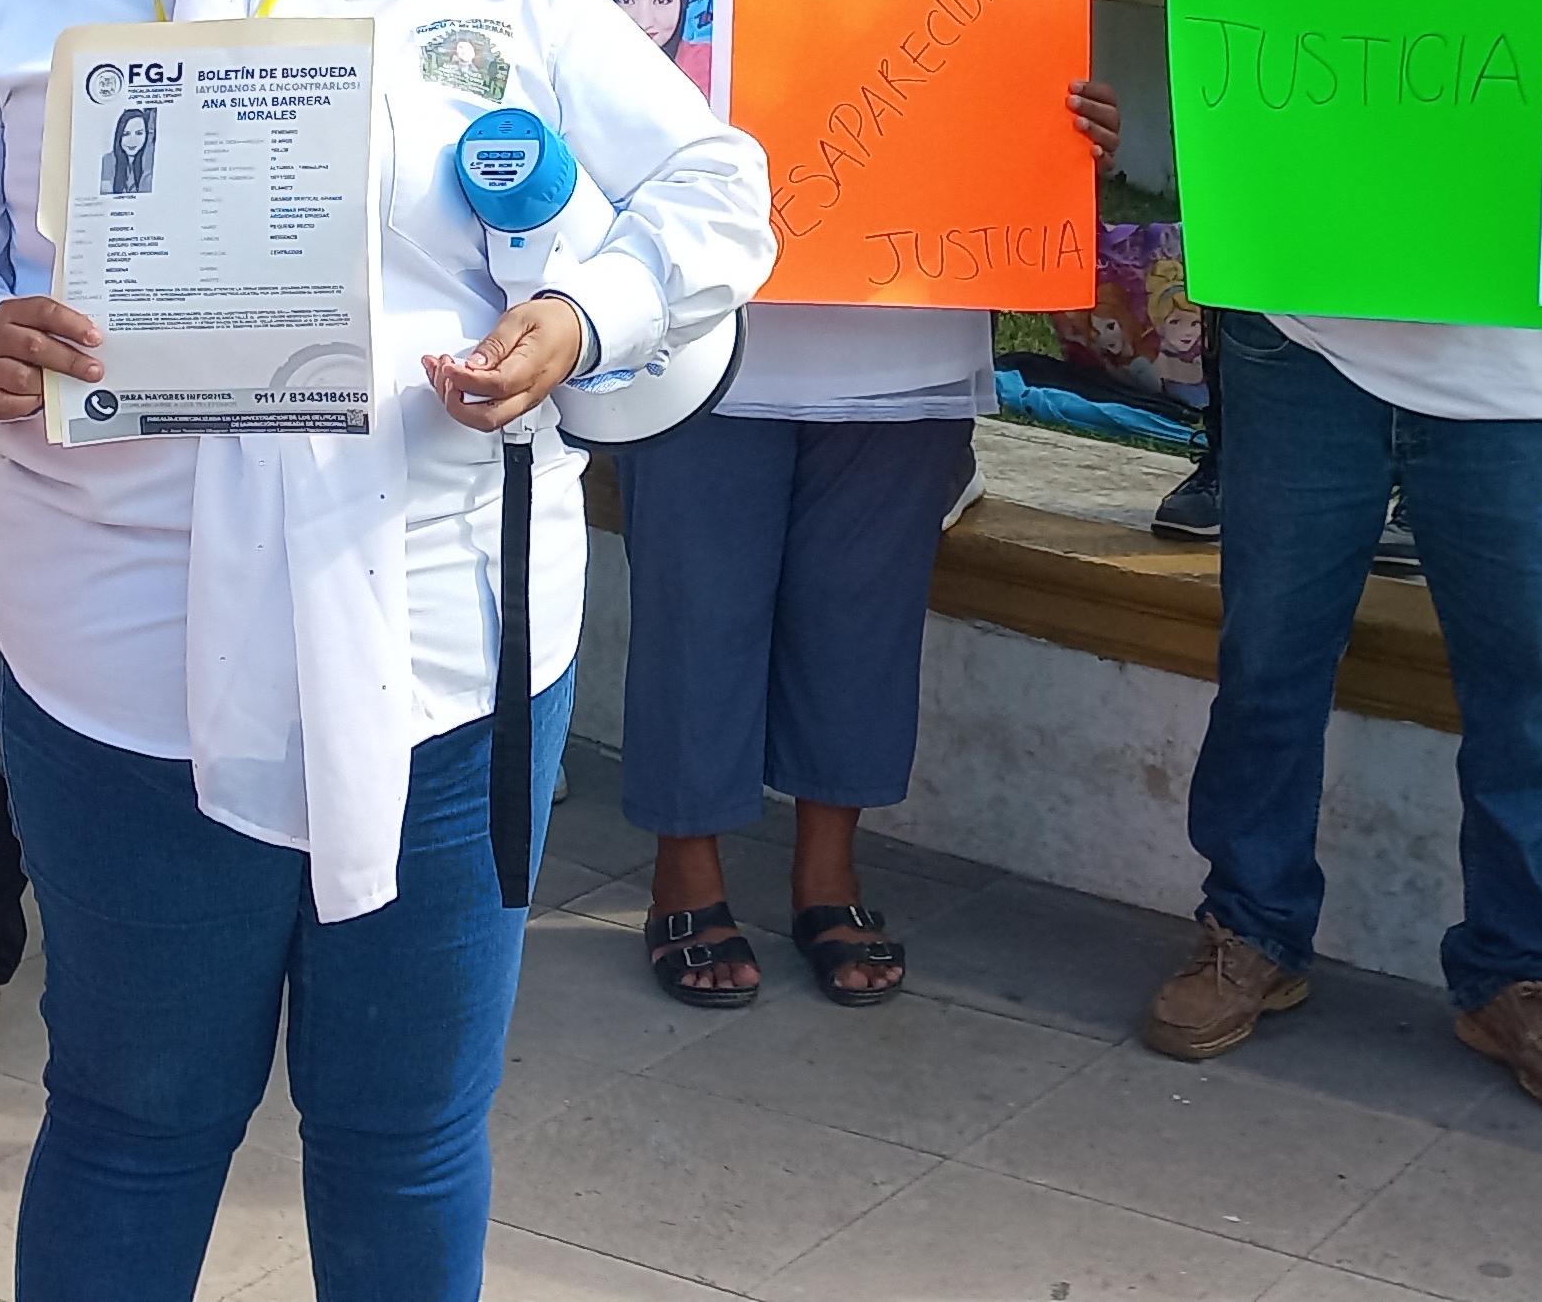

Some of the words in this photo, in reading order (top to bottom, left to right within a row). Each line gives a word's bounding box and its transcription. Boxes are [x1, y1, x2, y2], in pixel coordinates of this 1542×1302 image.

[1184, 15, 1528, 110] JUSTICIA
[128, 62, 183, 84] FGJ
[198, 66, 255, 81] BOLETÍN
[259, 68, 278, 79] DE
[282, 67, 357, 80] BUSQUEDA
[202, 99, 227, 109] ANA
[230, 97, 268, 108] SILVIA
[271, 96, 331, 107] BARRERA
[237, 110, 297, 120] MORALES
[865, 219, 1084, 287] JUSTICIA
[255, 393, 275, 403] 911
[279, 392, 286, 403] /
[290, 392, 369, 403] 8343186150
